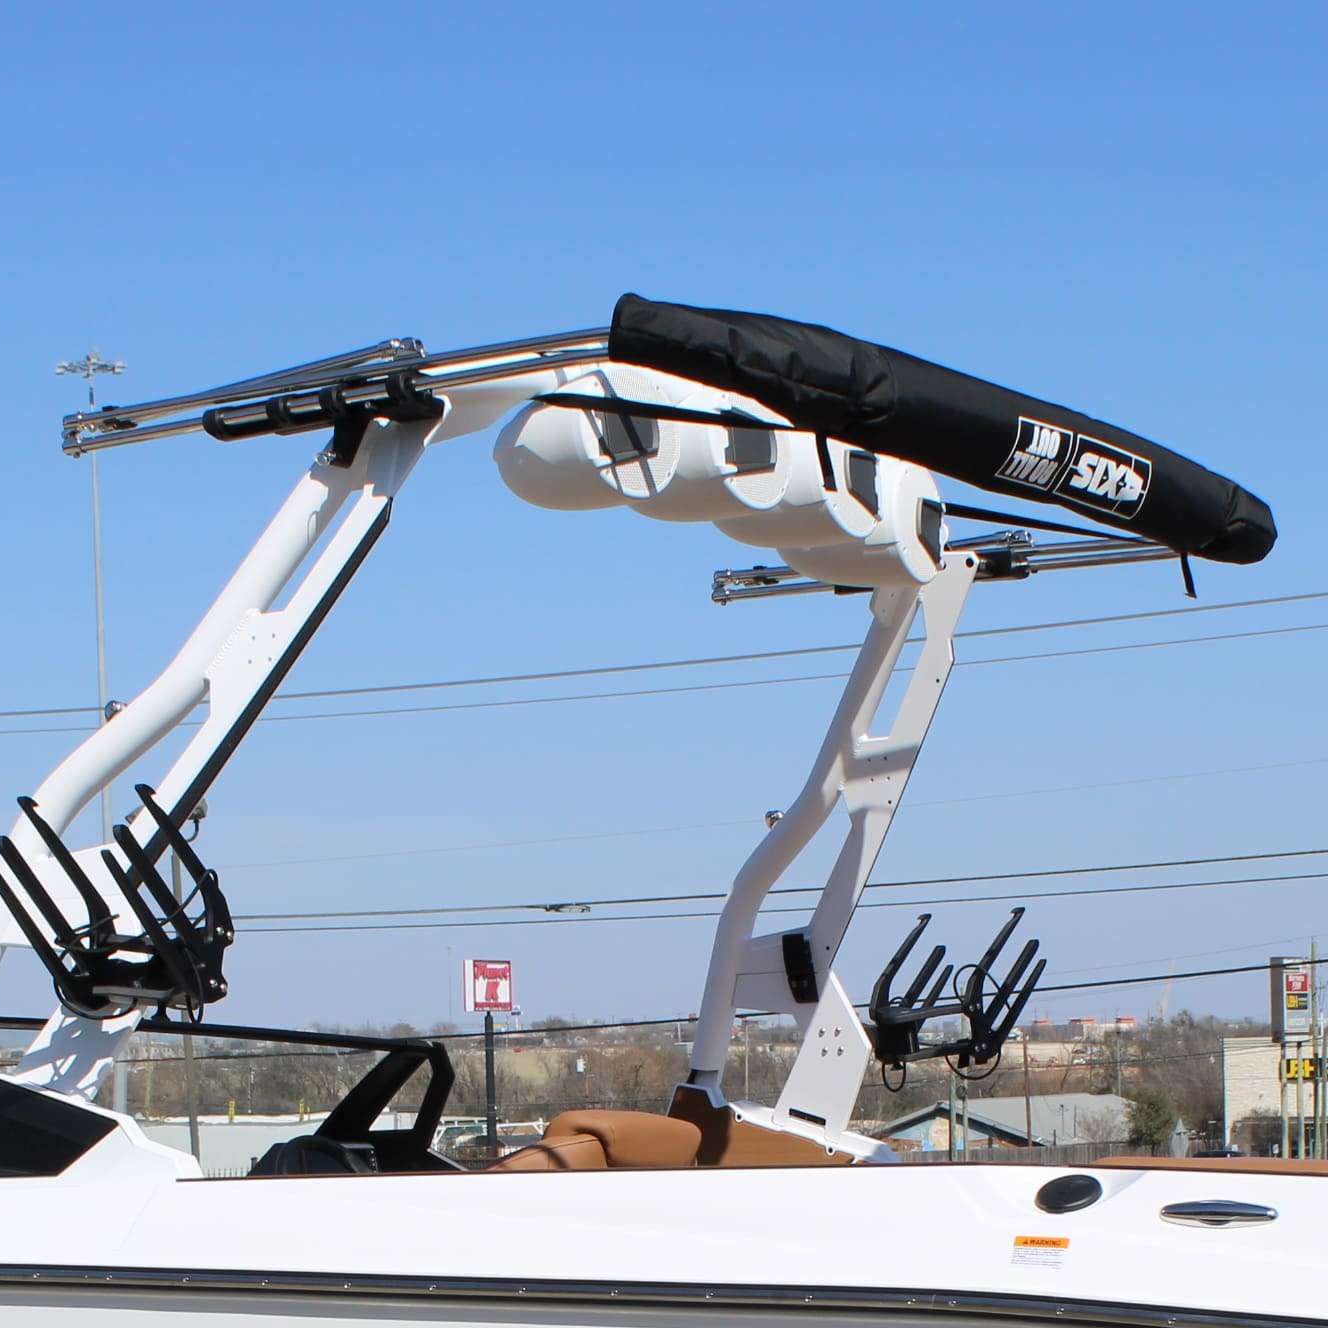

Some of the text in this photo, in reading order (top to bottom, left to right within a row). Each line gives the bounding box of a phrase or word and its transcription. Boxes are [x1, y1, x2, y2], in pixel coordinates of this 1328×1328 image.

[1025, 425, 1061, 460] OUT
[1005, 451, 1040, 481] ALL
[1069, 451, 1144, 502] AXIS
